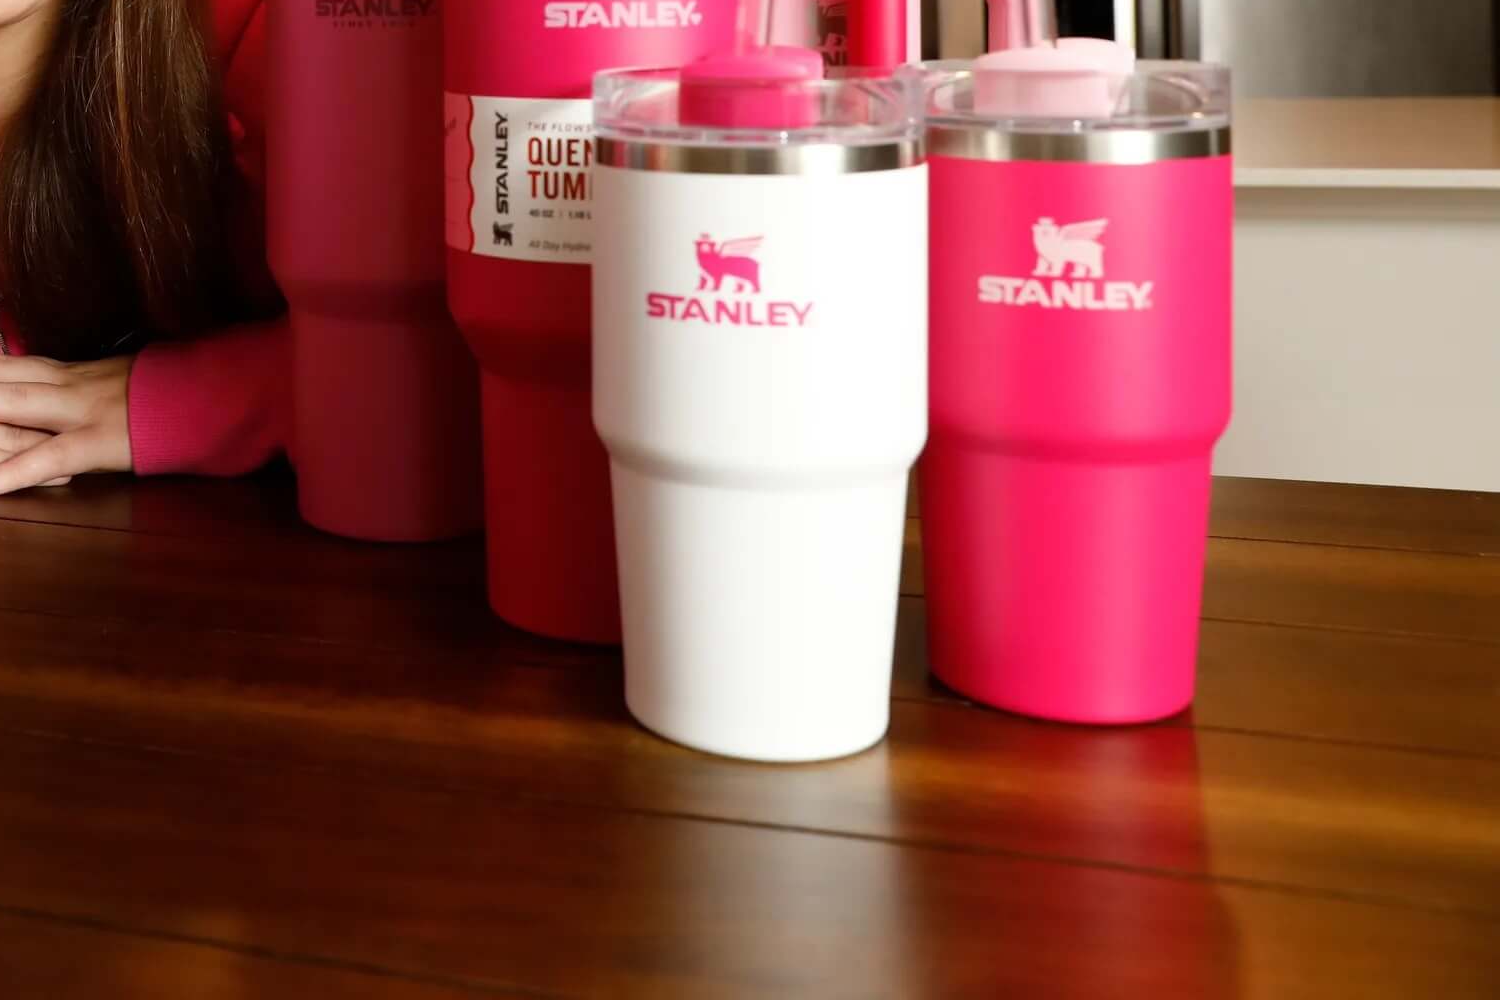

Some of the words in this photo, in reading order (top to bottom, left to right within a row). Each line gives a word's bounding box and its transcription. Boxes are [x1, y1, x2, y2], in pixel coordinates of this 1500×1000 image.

[543, 0, 696, 28] STANLEY
[495, 111, 509, 215] STANLEY
[647, 292, 812, 327] STANLEY
[976, 275, 1154, 311] STANLEY
